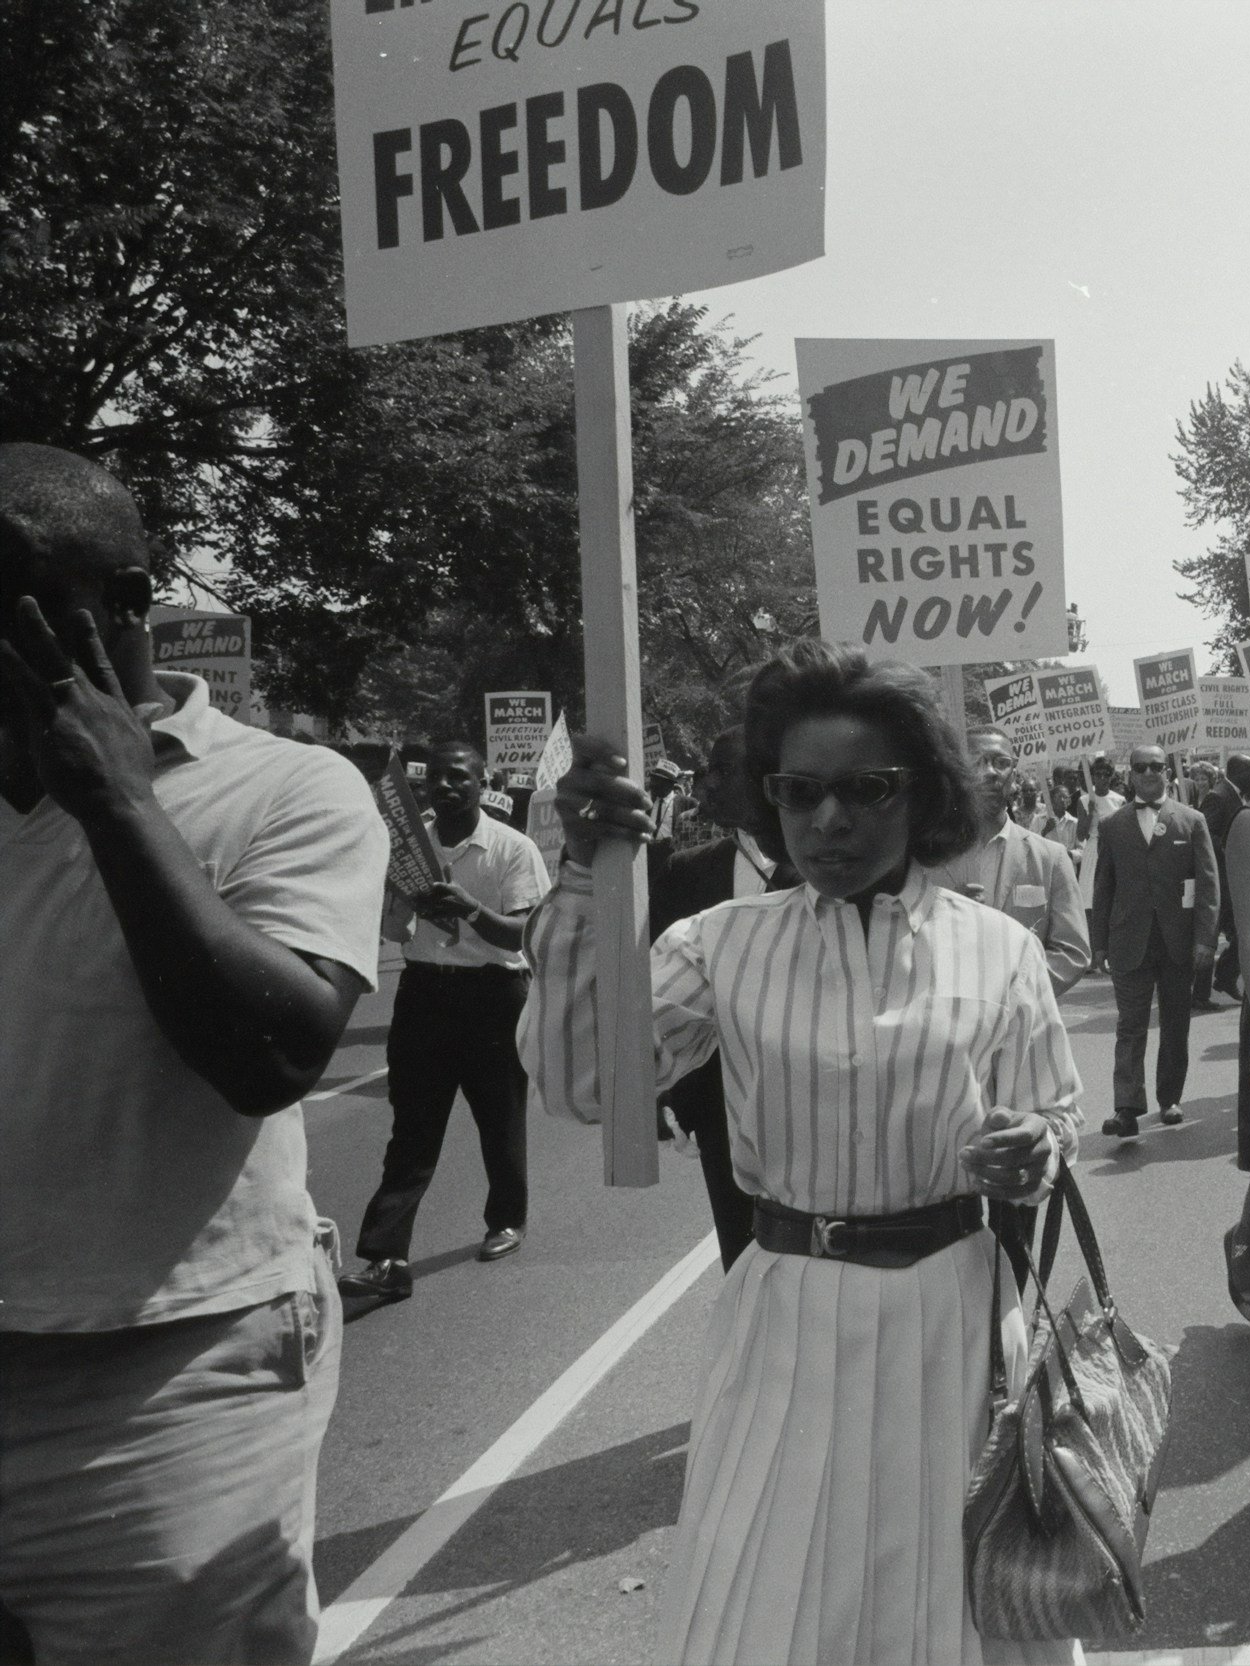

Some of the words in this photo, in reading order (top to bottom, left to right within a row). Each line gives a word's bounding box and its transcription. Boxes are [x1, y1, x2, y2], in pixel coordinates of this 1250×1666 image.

[448, 0, 700, 72] EQUALS
[373, 38, 803, 250] FREEDOM
[889, 363, 971, 420] WE
[833, 397, 1039, 486] DEMAND
[856, 495, 1027, 535] EQUAL
[857, 541, 1036, 584] RIGHTS
[862, 581, 1043, 646] NOW!
[182, 620, 217, 637] WE
[158, 635, 243, 660] DEMAND
[1158, 660, 1174, 673] WE
[1008, 677, 1031, 697] WE
[1058, 675, 1076, 686] WE
[1145, 669, 1189, 690] MARCH
[1045, 682, 1093, 700] MARCH
[1161, 685, 1178, 694] FOR
[1200, 684, 1219, 693] CIVIL
[1222, 684, 1249, 694] RIGHTS
[508, 699, 527, 707] WE
[997, 690, 1036, 718] DEMA
[1062, 696, 1081, 704] FOR
[1145, 700, 1170, 716] FIRST
[1171, 694, 1197, 707] CLASS
[1214, 700, 1234, 708] FULL
[494, 707, 542, 718] MARCH
[1003, 715, 1021, 727] AN
[1025, 712, 1040, 722] EN
[1045, 703, 1102, 722] INTEGRATED
[1145, 706, 1200, 729] CITIZENSHIP
[495, 726, 545, 734] EFFECTIVE
[1014, 723, 1043, 736] POLICE
[1048, 717, 1105, 736] SCHOOLS
[1156, 722, 1198, 747] NOW!
[1206, 726, 1248, 739] REEDOM
[489, 735, 513, 743] CIVIL
[514, 734, 549, 742] RIGHTS
[504, 742, 532, 750] LAWS
[1009, 731, 1045, 745] BRUTALIT
[1056, 730, 1105, 753] NOW!
[495, 751, 544, 764] NOW!
[380, 773, 409, 827] MARCH
